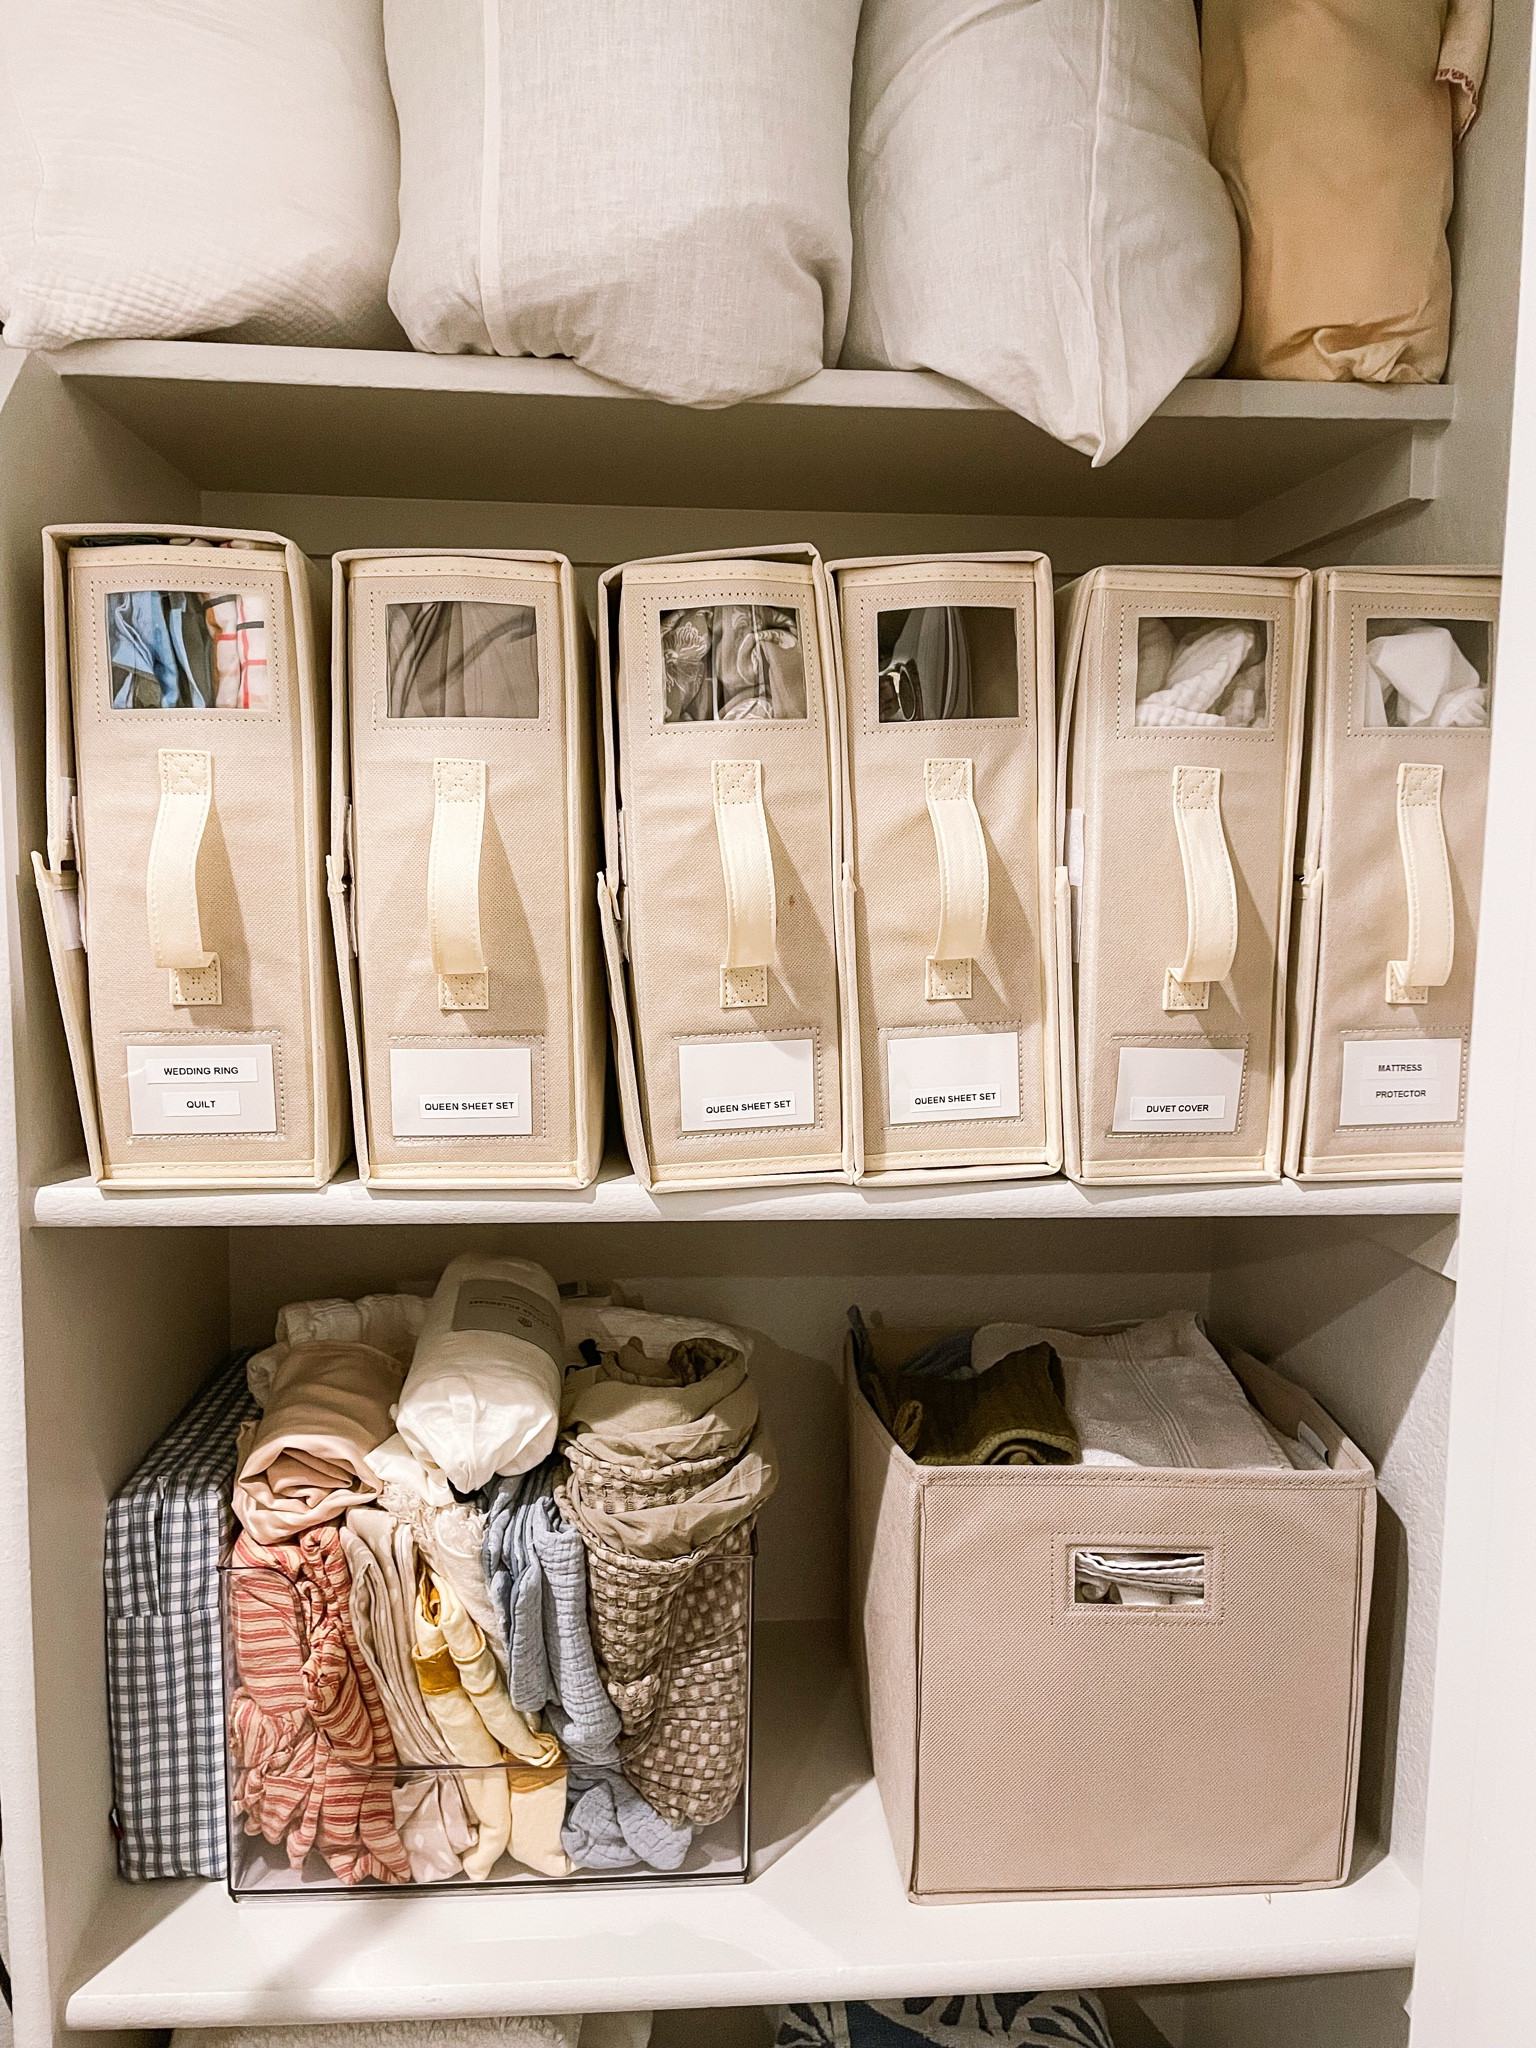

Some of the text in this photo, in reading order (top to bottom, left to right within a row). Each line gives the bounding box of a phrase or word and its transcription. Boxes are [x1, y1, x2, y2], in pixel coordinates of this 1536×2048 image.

[163, 1066, 239, 1076] WEDDING RING
[1377, 1063, 1423, 1072] MATTRESS
[914, 1092, 997, 1106] QUEEN SHEET SET
[1375, 1089, 1427, 1099] PROTECTOR
[186, 1099, 216, 1109] QUILT
[424, 1101, 515, 1111] QUEEN SHEET SET
[705, 1099, 792, 1115] QUEEN SHEET SET
[1146, 1103, 1210, 1113] DUVET COVER
